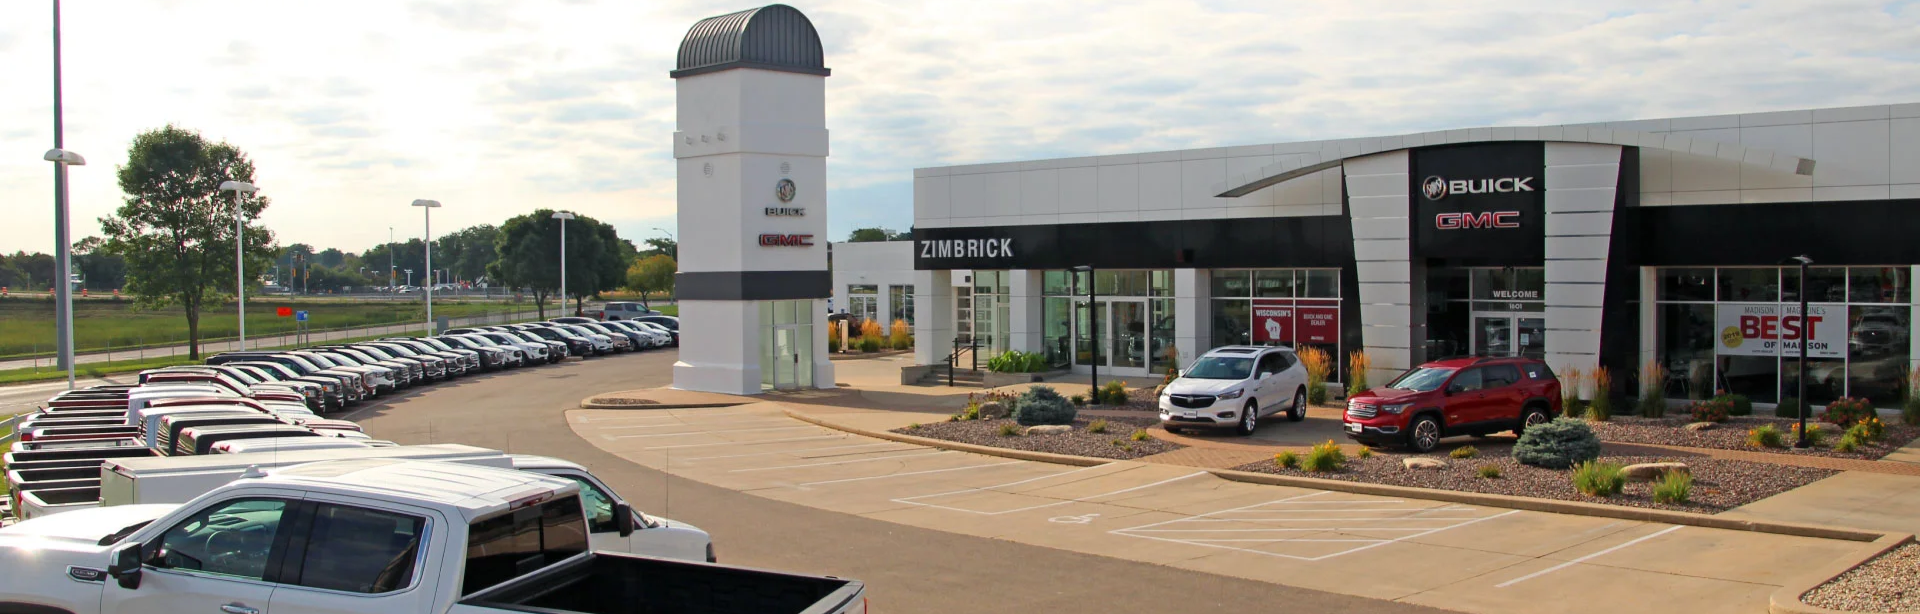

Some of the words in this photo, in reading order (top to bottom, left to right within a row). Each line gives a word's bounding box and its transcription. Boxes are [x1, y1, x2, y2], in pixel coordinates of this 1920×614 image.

[1449, 177, 1534, 194] BUICK
[765, 207, 805, 216] BUICK
[1436, 211, 1520, 229] GMC
[759, 234, 814, 246] GMC
[920, 238, 1014, 258] ZIMBRICK
[1493, 290, 1538, 298] WELCOME
[1256, 309, 1291, 317] WISCONSIN'S
[1744, 306, 1774, 314] MADISON
[1786, 306, 1826, 315] MAGZINE's
[1740, 315, 1823, 340] BEST
[1764, 341, 1777, 349] OF
